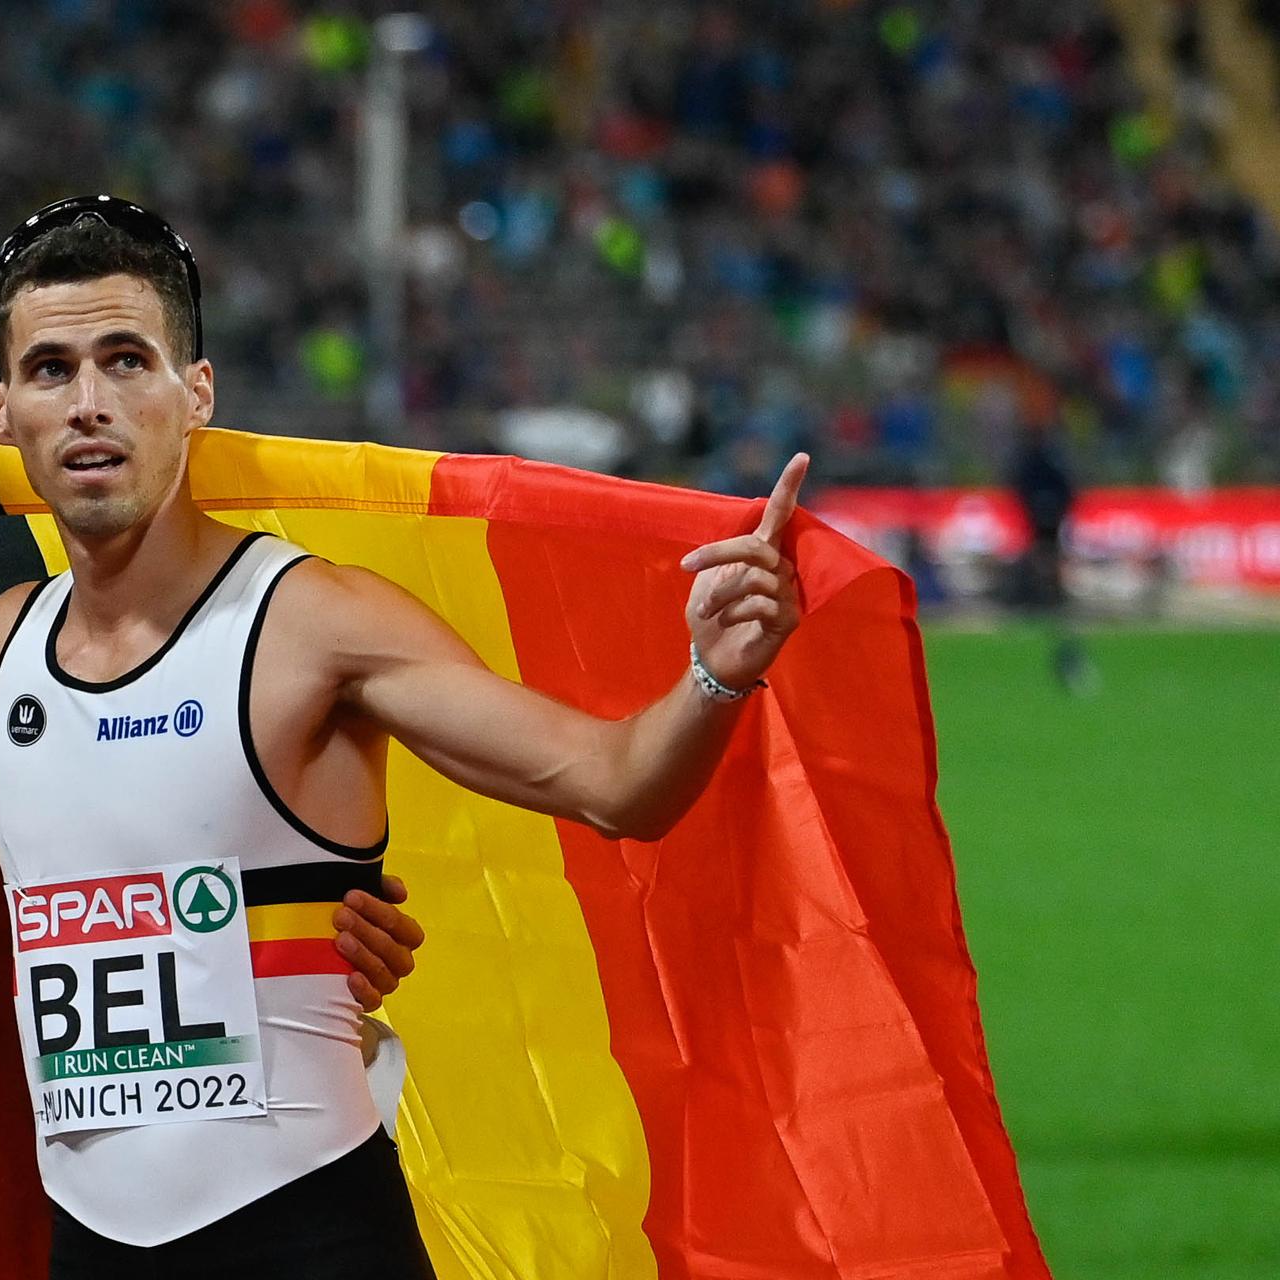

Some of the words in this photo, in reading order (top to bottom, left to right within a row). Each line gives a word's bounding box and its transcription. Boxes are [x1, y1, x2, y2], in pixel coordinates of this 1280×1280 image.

[96, 713, 169, 742] Allianz
[18, 887, 166, 942] SPAR
[30, 951, 226, 1058] BEL
[54, 1056, 60, 1076] I
[64, 1051, 109, 1075] RUN
[42, 1083, 143, 1122] MUNICH
[154, 1073, 249, 1113] 2022
